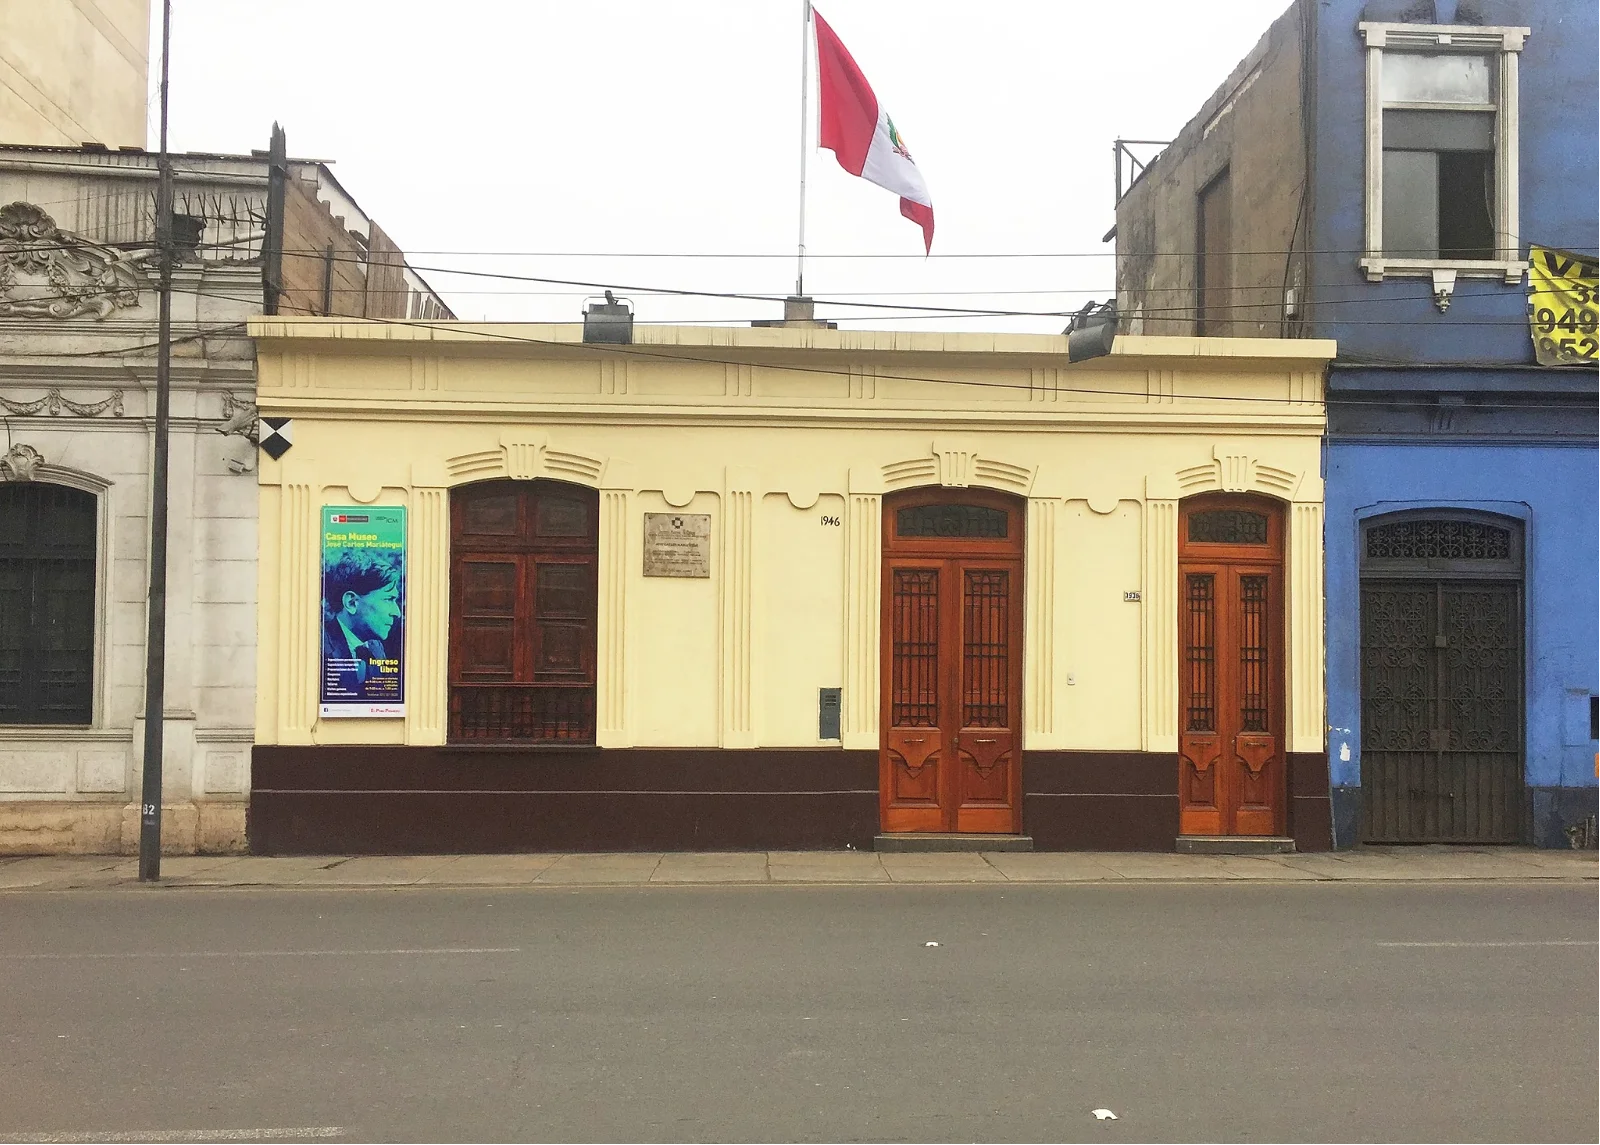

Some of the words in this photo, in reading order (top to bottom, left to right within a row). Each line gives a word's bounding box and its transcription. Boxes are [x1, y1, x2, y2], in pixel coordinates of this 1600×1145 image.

[820, 515, 840, 526] 1946
[325, 533, 346, 541] Casa
[348, 533, 378, 541] Museo
[369, 658, 399, 666] Ingreso
